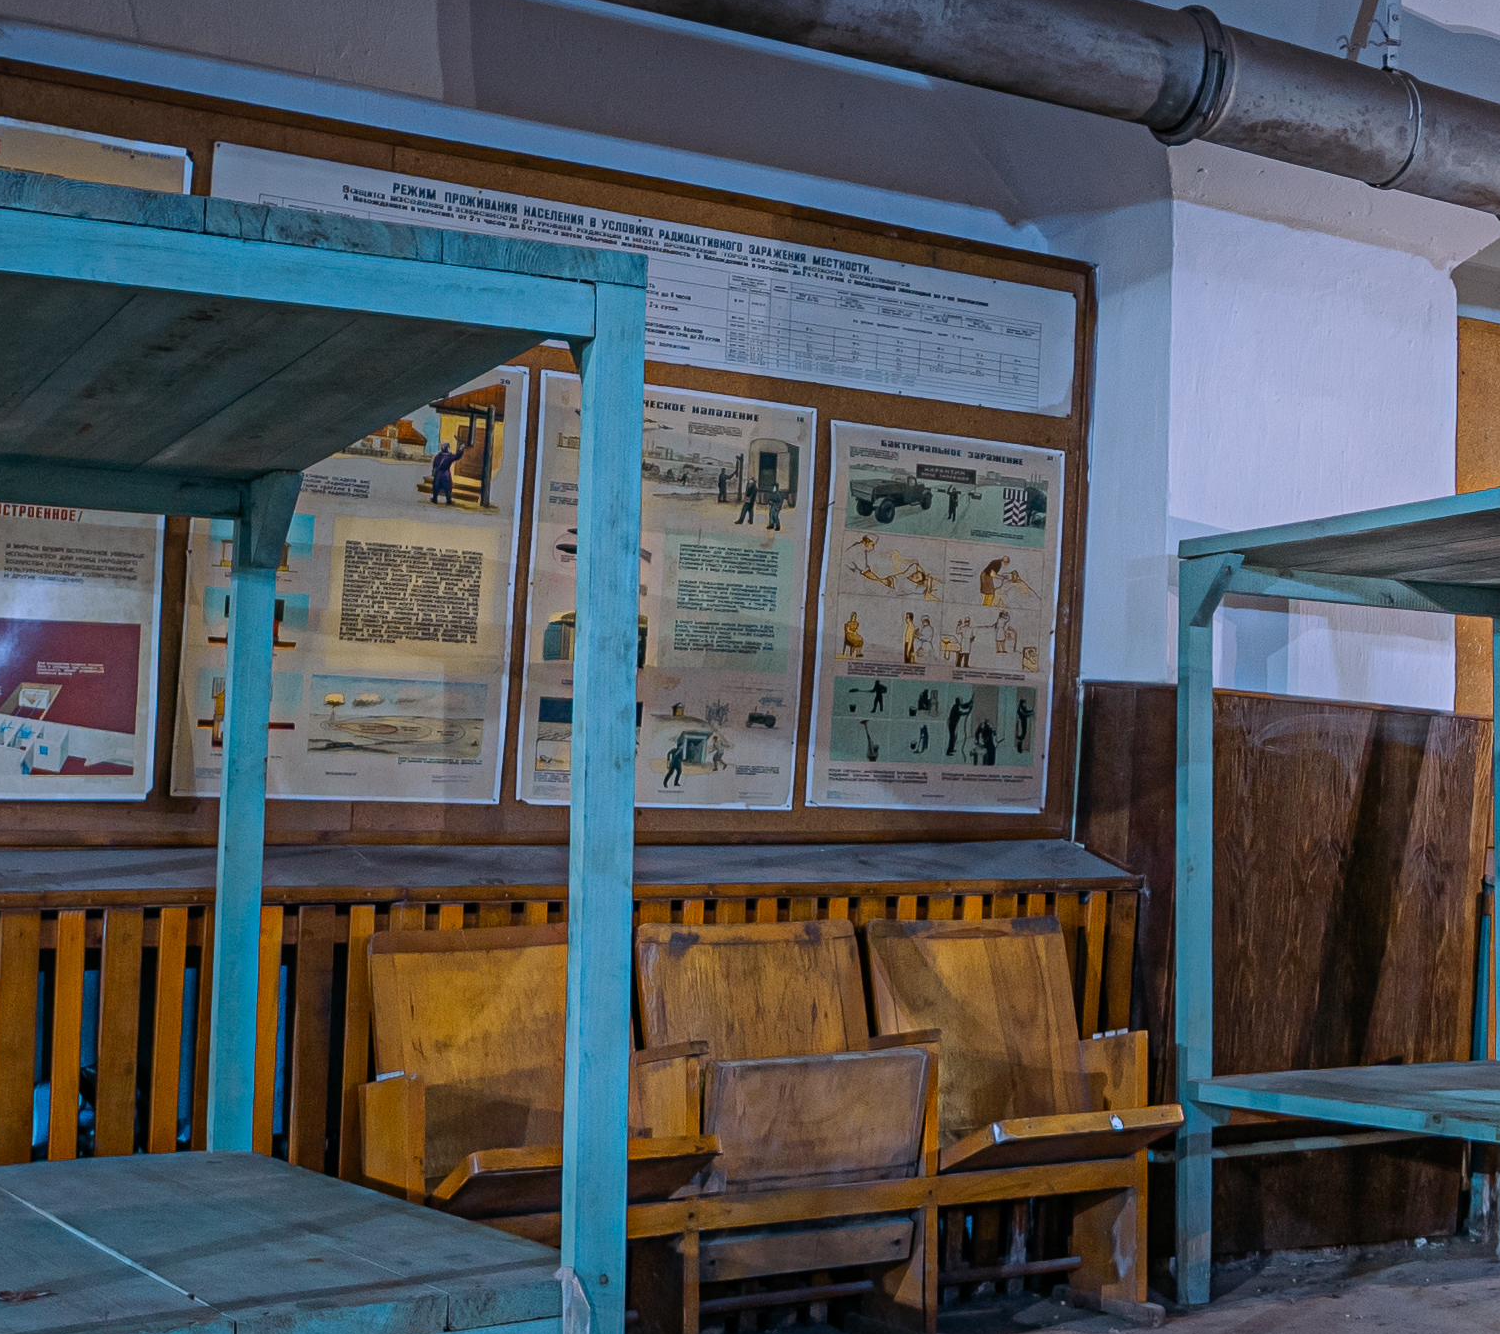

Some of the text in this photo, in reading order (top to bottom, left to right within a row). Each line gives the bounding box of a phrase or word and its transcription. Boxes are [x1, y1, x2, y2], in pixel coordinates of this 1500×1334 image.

[391, 181, 873, 276] РЕЖИМ ПРОЖИВАНИЯ НАСЕЛЕНИЯ В УСЛОВИЯХ РАДИОАКТИВНОГО ЗАРАЖЕНИЯ МЕСТНОСТИ.
[643, 399, 759, 421] ЧЕСКОЕ НАПАДЕНИЕ
[880, 438, 962, 457] БАКТЕРИАЛЬНОЕ
[967, 451, 1024, 466] ЗАРАЖЕНИЕ
